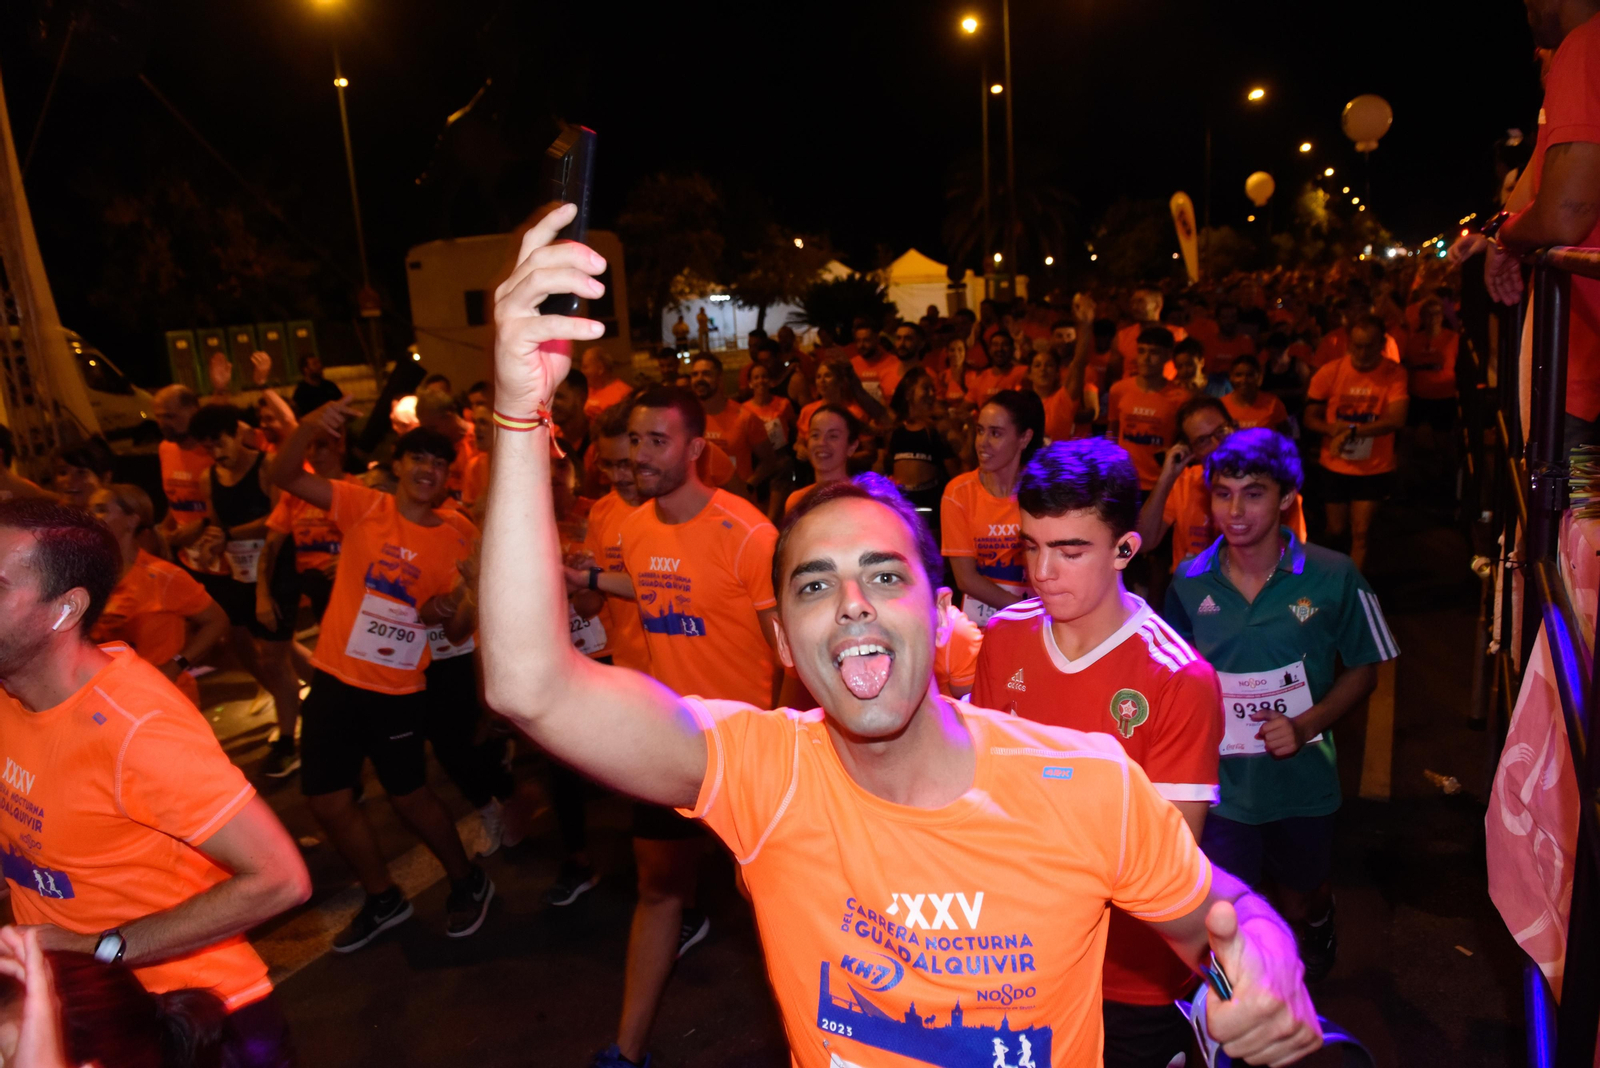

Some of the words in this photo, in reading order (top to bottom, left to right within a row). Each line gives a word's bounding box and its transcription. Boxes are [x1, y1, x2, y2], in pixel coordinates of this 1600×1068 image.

[649, 556, 680, 572] XXXV
[367, 620, 415, 643] 20790
[2, 756, 36, 795] XXXV
[10, 791, 45, 819] NOCTURNA
[846, 897, 920, 946] CARRERA
[925, 933, 1034, 951] NOCTURNA
[841, 912, 854, 933] DEL
[855, 920, 1036, 975] GUADALQUIVIR
[822, 1018, 854, 1037] 2023
